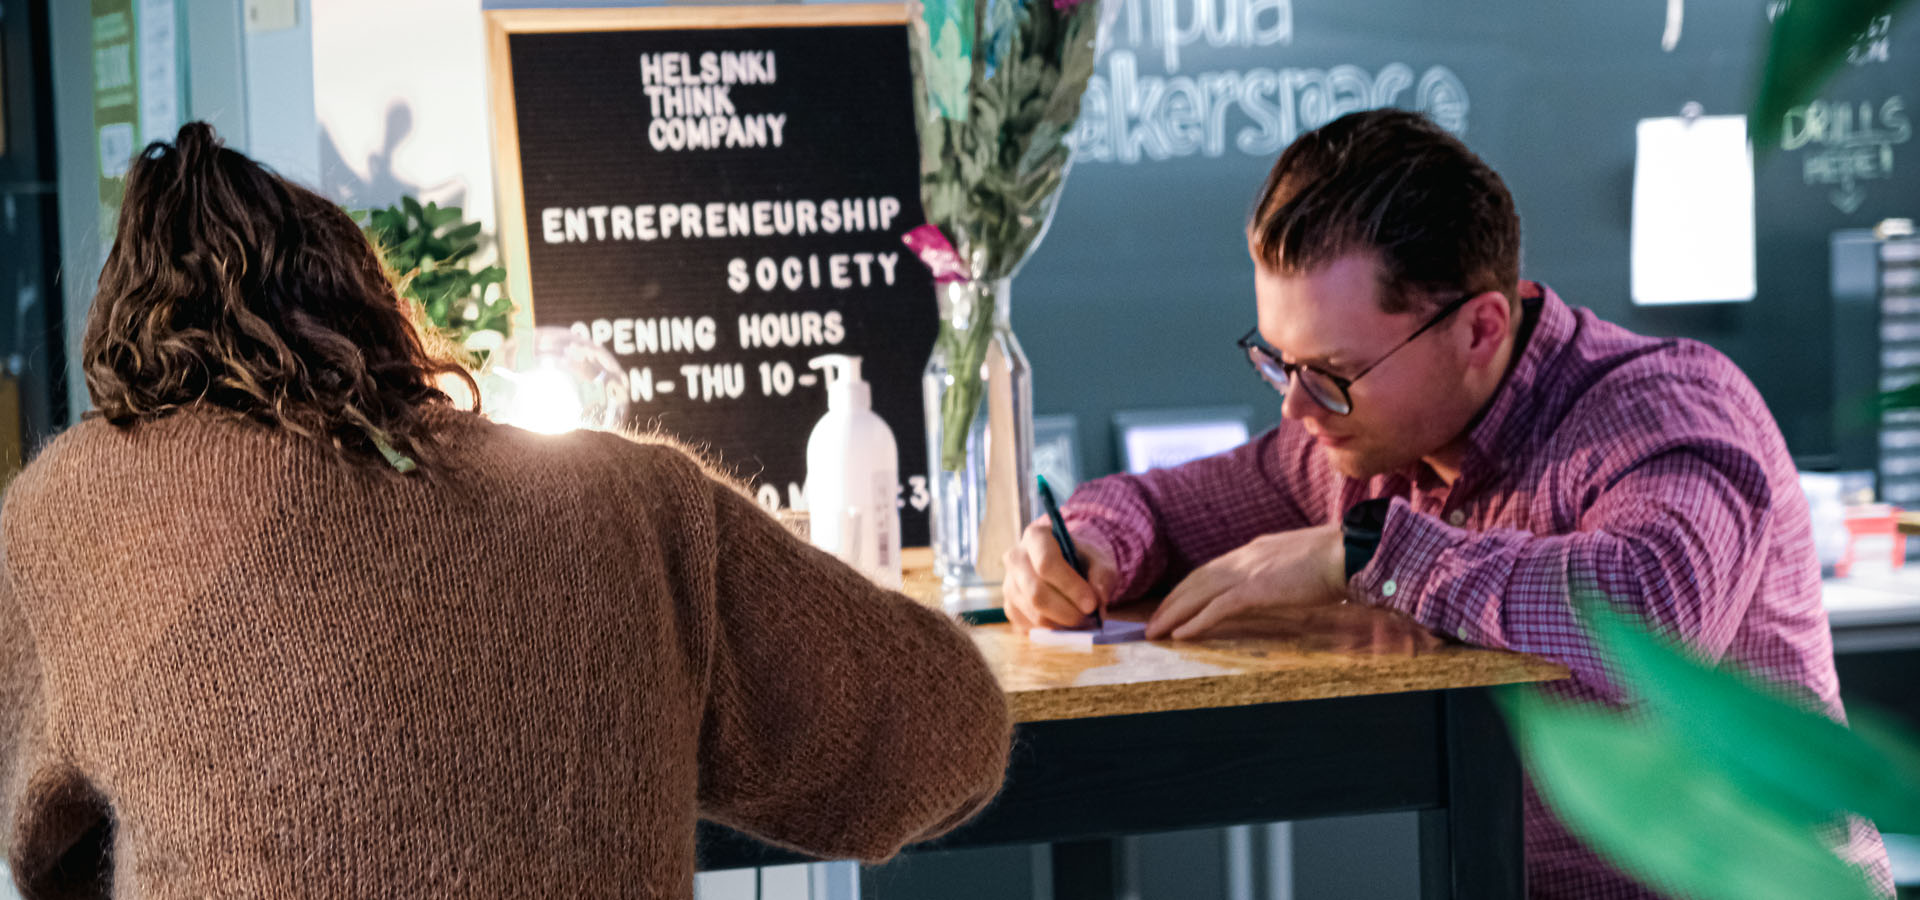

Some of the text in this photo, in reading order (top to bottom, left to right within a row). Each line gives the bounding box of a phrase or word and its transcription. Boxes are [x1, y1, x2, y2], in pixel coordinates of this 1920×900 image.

[640, 50, 777, 84] HELSINKI
[643, 85, 735, 118] THINK
[648, 113, 787, 151] COMPANY
[541, 197, 900, 244] ENTREPRENEURSHIP
[727, 253, 898, 293] SOCIETY
[738, 311, 845, 349] HOURS
